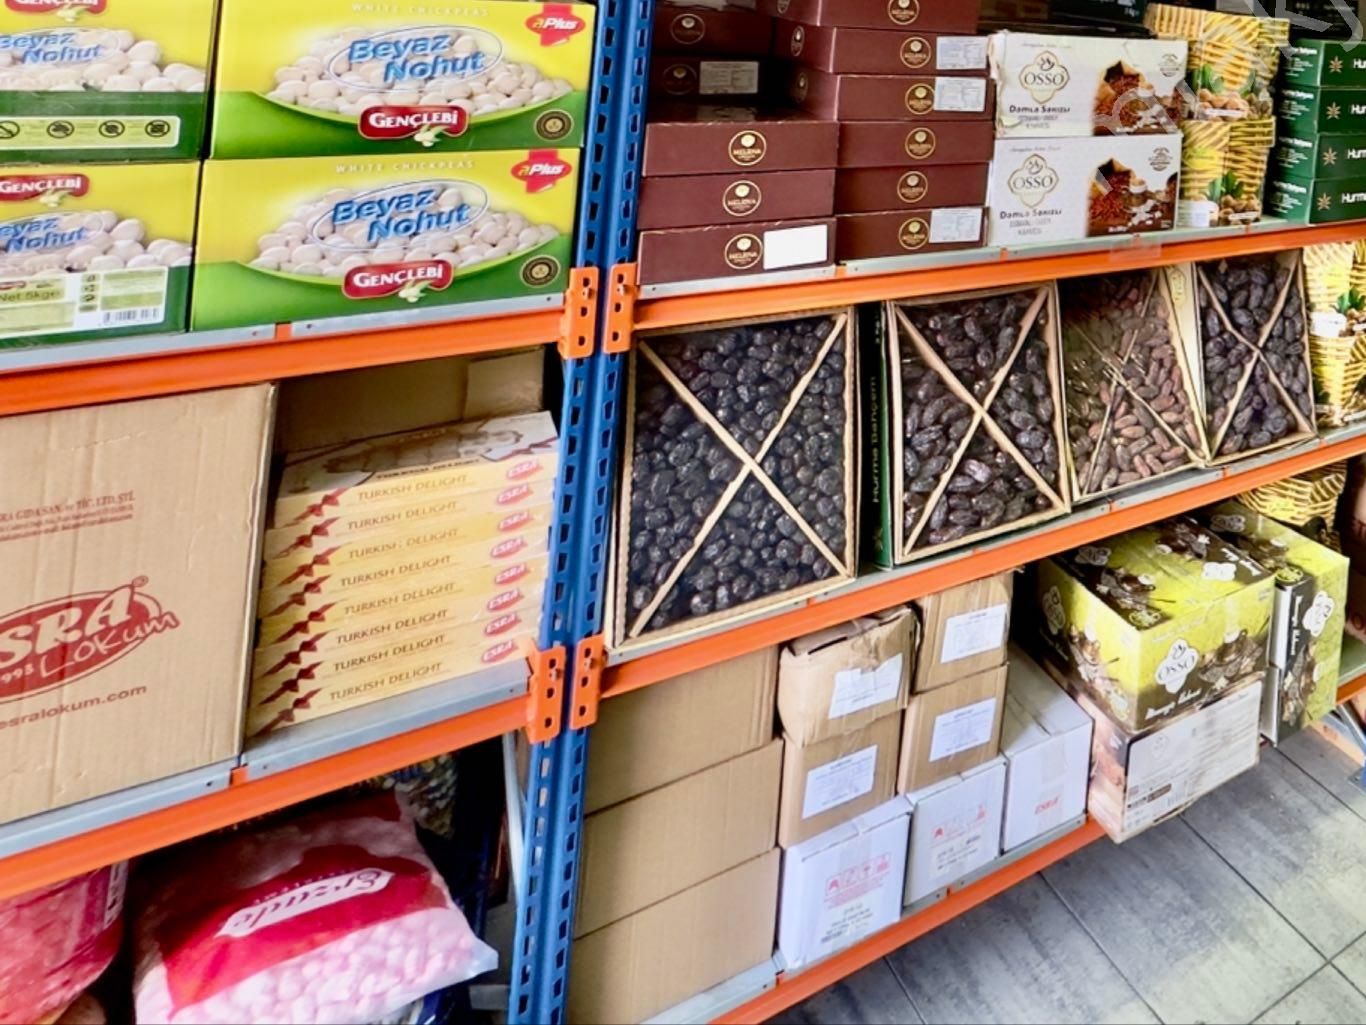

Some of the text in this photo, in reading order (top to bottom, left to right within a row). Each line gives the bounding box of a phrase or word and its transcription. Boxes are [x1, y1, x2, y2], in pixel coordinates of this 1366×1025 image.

[347, 33, 456, 64] Beyaz
[382, 49, 487, 84] Nohut
[1023, 72, 1065, 86] OSSO
[1012, 176, 1054, 190] OSSO
[331, 187, 442, 226] Beyaz
[366, 201, 472, 244] Nohut
[0, 216, 59, 238] eyaz
[359, 474, 467, 501] TURKISH DELIGHT
[348, 501, 457, 530] TURKISH DELIGHT
[406, 528, 458, 547] DELIGHT
[341, 556, 451, 587] TURKISH DELIGHT
[344, 582, 455, 615] TURKISH DELIGHT
[0, 583, 134, 669] SRA
[336, 609, 448, 644] TURKISH DELIGHT
[333, 635, 446, 672] TURKISH DELIGHT
[330, 663, 442, 700] TURKISH DELIGHT
